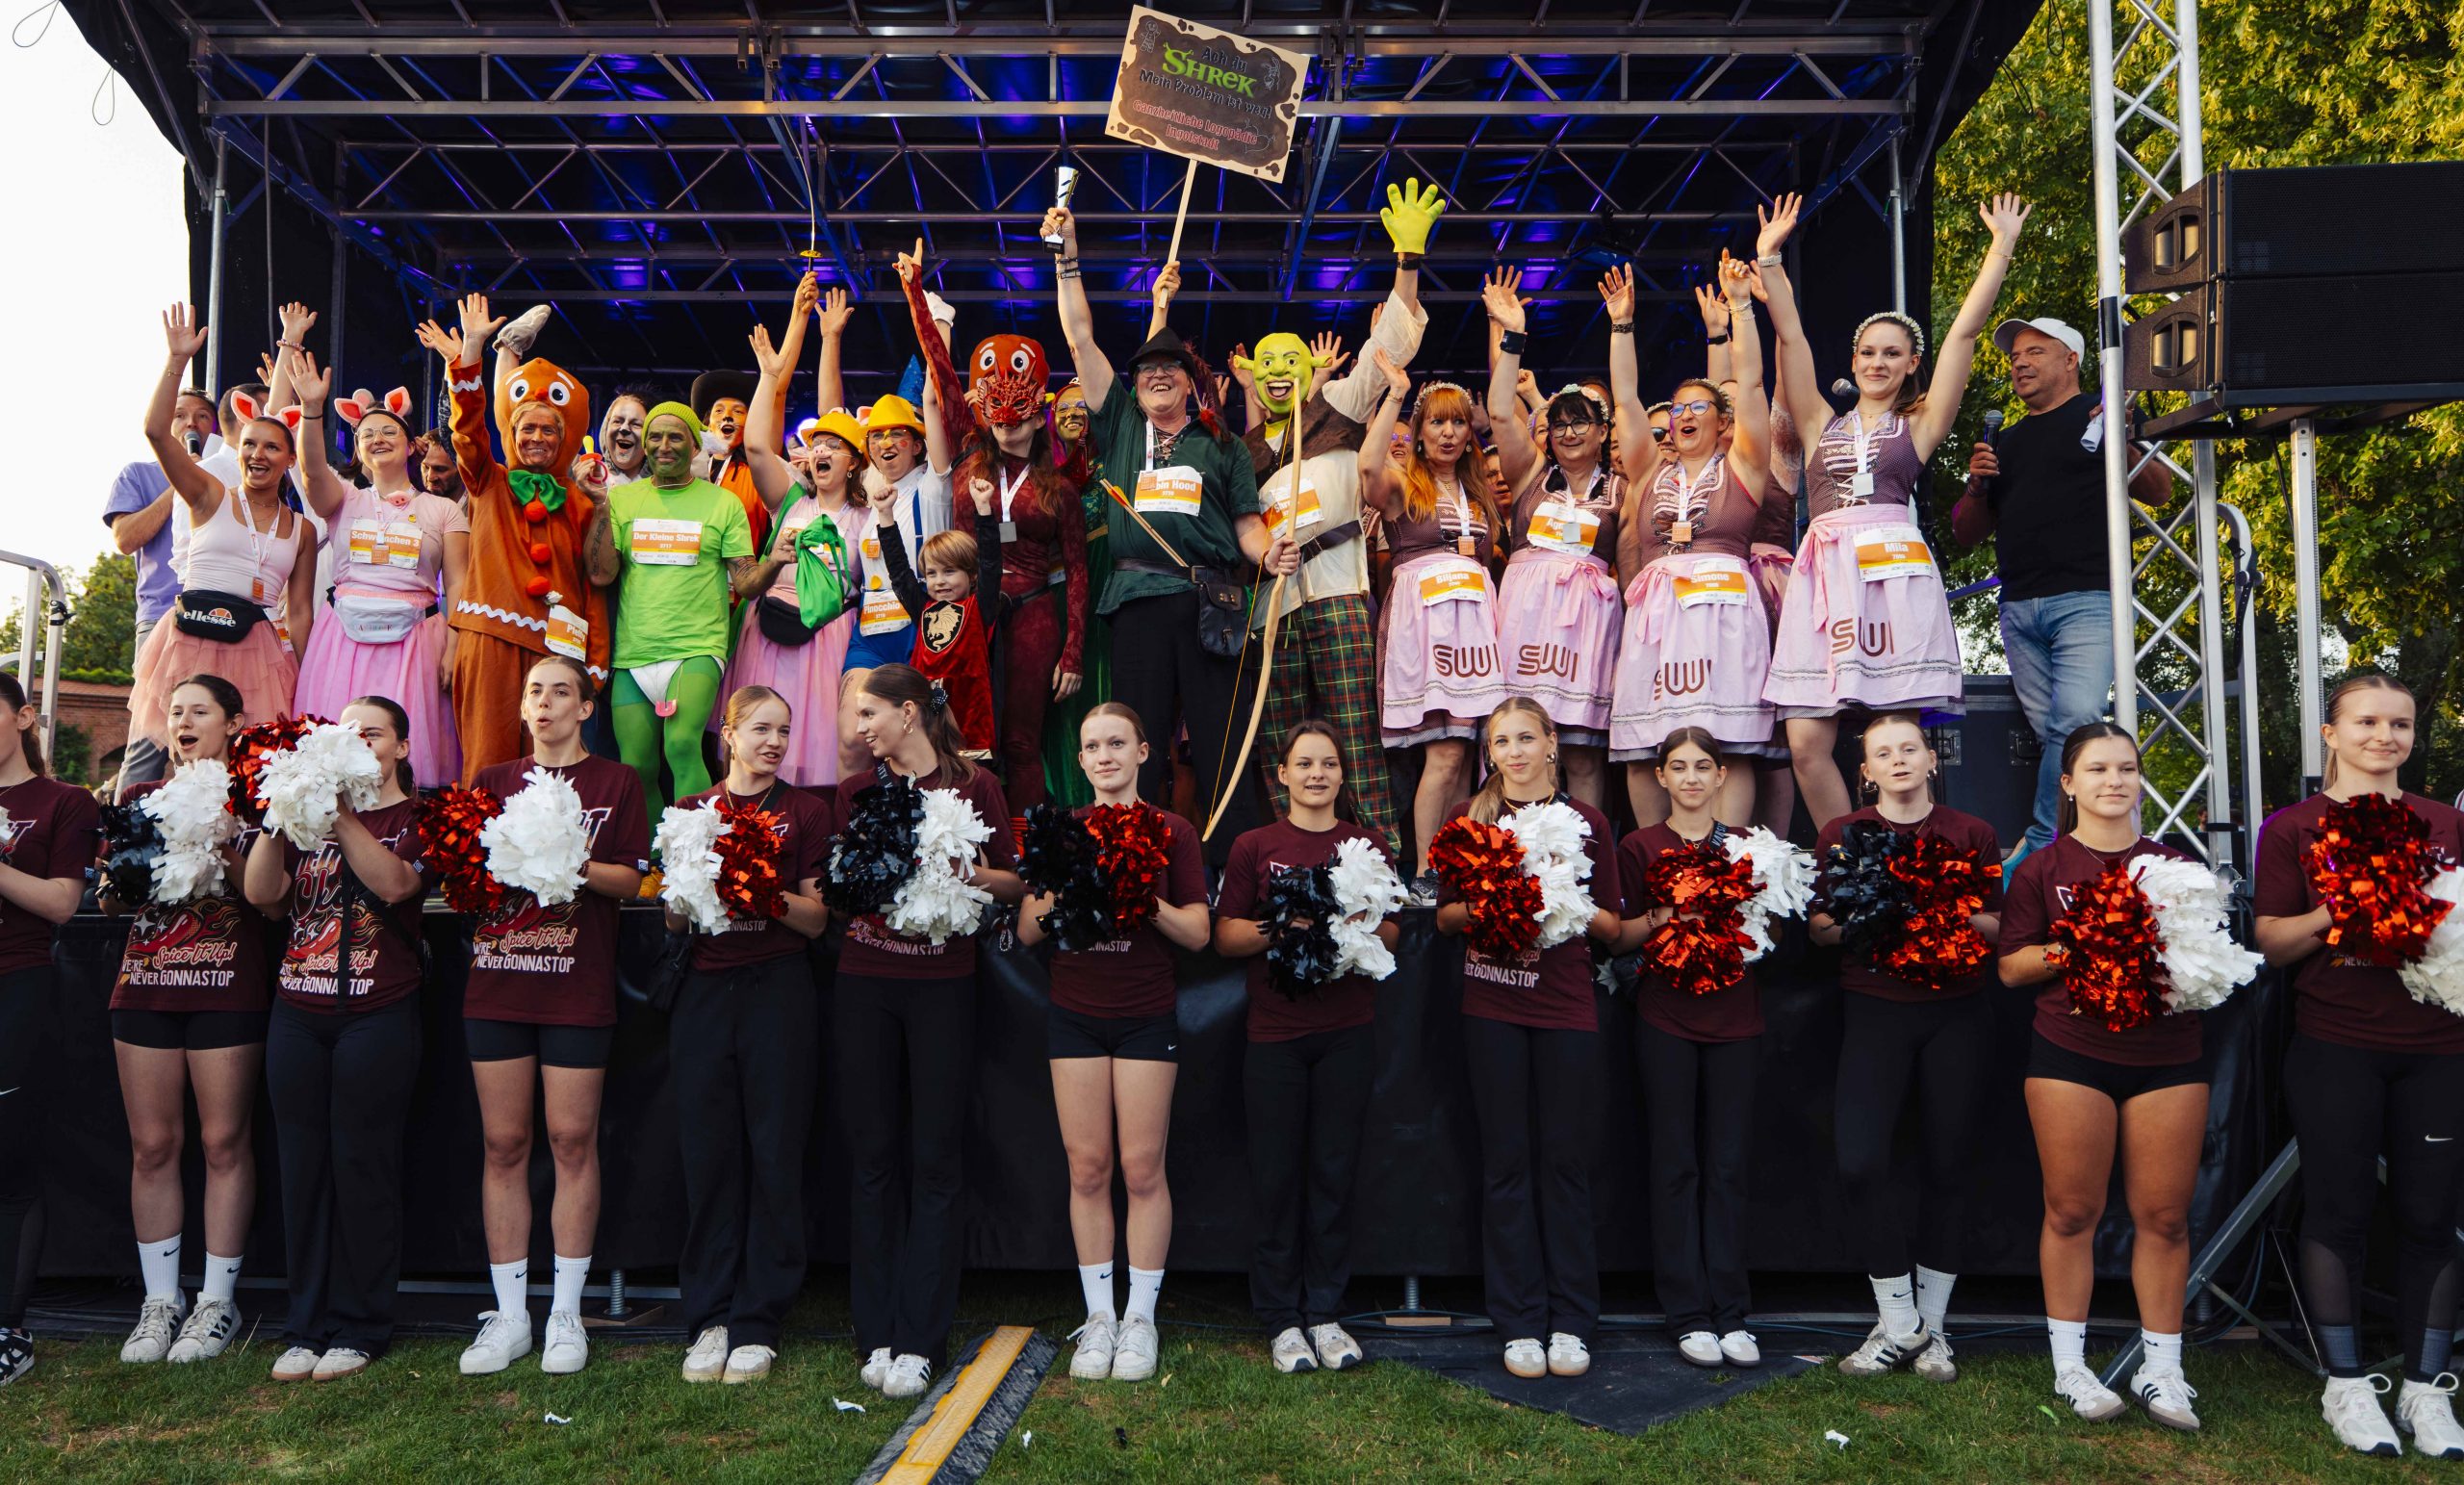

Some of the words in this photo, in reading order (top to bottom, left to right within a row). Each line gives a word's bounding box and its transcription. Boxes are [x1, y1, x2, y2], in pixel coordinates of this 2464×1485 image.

[1201, 46, 1228, 65] Ach
[1139, 69, 1172, 90] Mein
[1174, 77, 1226, 106] Problem
[1227, 95, 1243, 111] ist
[1132, 99, 1204, 130] Ganzheitliche
[1204, 118, 1259, 145] Logopädie
[1165, 124, 1219, 151] Ingolstadt
[1172, 479, 1196, 492] Hood
[351, 530, 411, 546] Schwnchen
[413, 539, 420, 548] 3
[649, 532, 674, 542] Kleine
[677, 533, 700, 543] Shrek
[1884, 542, 1909, 552] Mila
[1436, 573, 1470, 584] Biljana
[1691, 574, 1730, 584] Simone
[863, 602, 901, 615] Pinocchio
[183, 609, 237, 627] ellesse
[1433, 643, 1502, 678] SWI
[1517, 643, 1578, 682] SWI
[500, 930, 536, 954] Spice
[152, 946, 191, 970] Spice
[130, 971, 159, 986] NEVER
